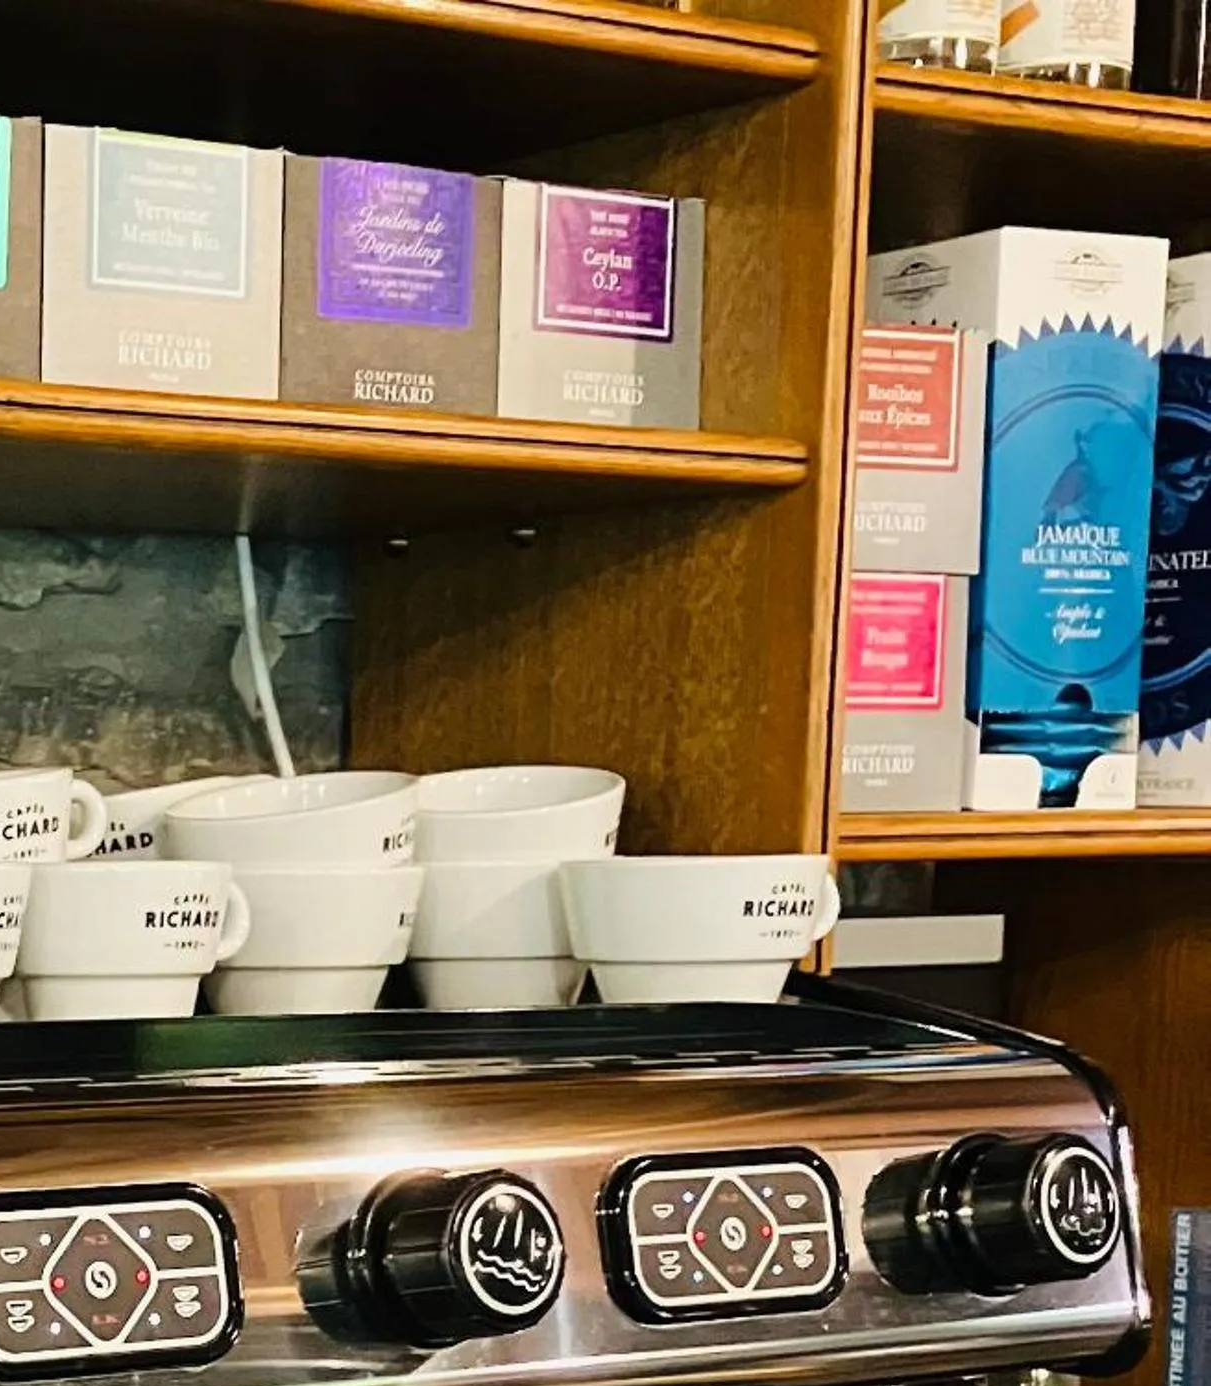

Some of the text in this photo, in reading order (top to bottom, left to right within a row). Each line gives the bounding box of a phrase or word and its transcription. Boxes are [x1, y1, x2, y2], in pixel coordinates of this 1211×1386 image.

[582, 246, 633, 272] Ceylan
[118, 328, 212, 351] COMPTOIRS
[117, 343, 212, 371] RICHARD
[355, 367, 436, 387] COMPTOIRS
[354, 381, 435, 405] RICHARD
[562, 383, 645, 406] RICHARD
[1035, 521, 1122, 550] JAMAÏQUE
[1060, 548, 1131, 567] MOUNTAIN
[145, 909, 220, 929] RICHARD
[742, 899, 816, 918] RICHARD
[1172, 1295, 1187, 1324] AU
